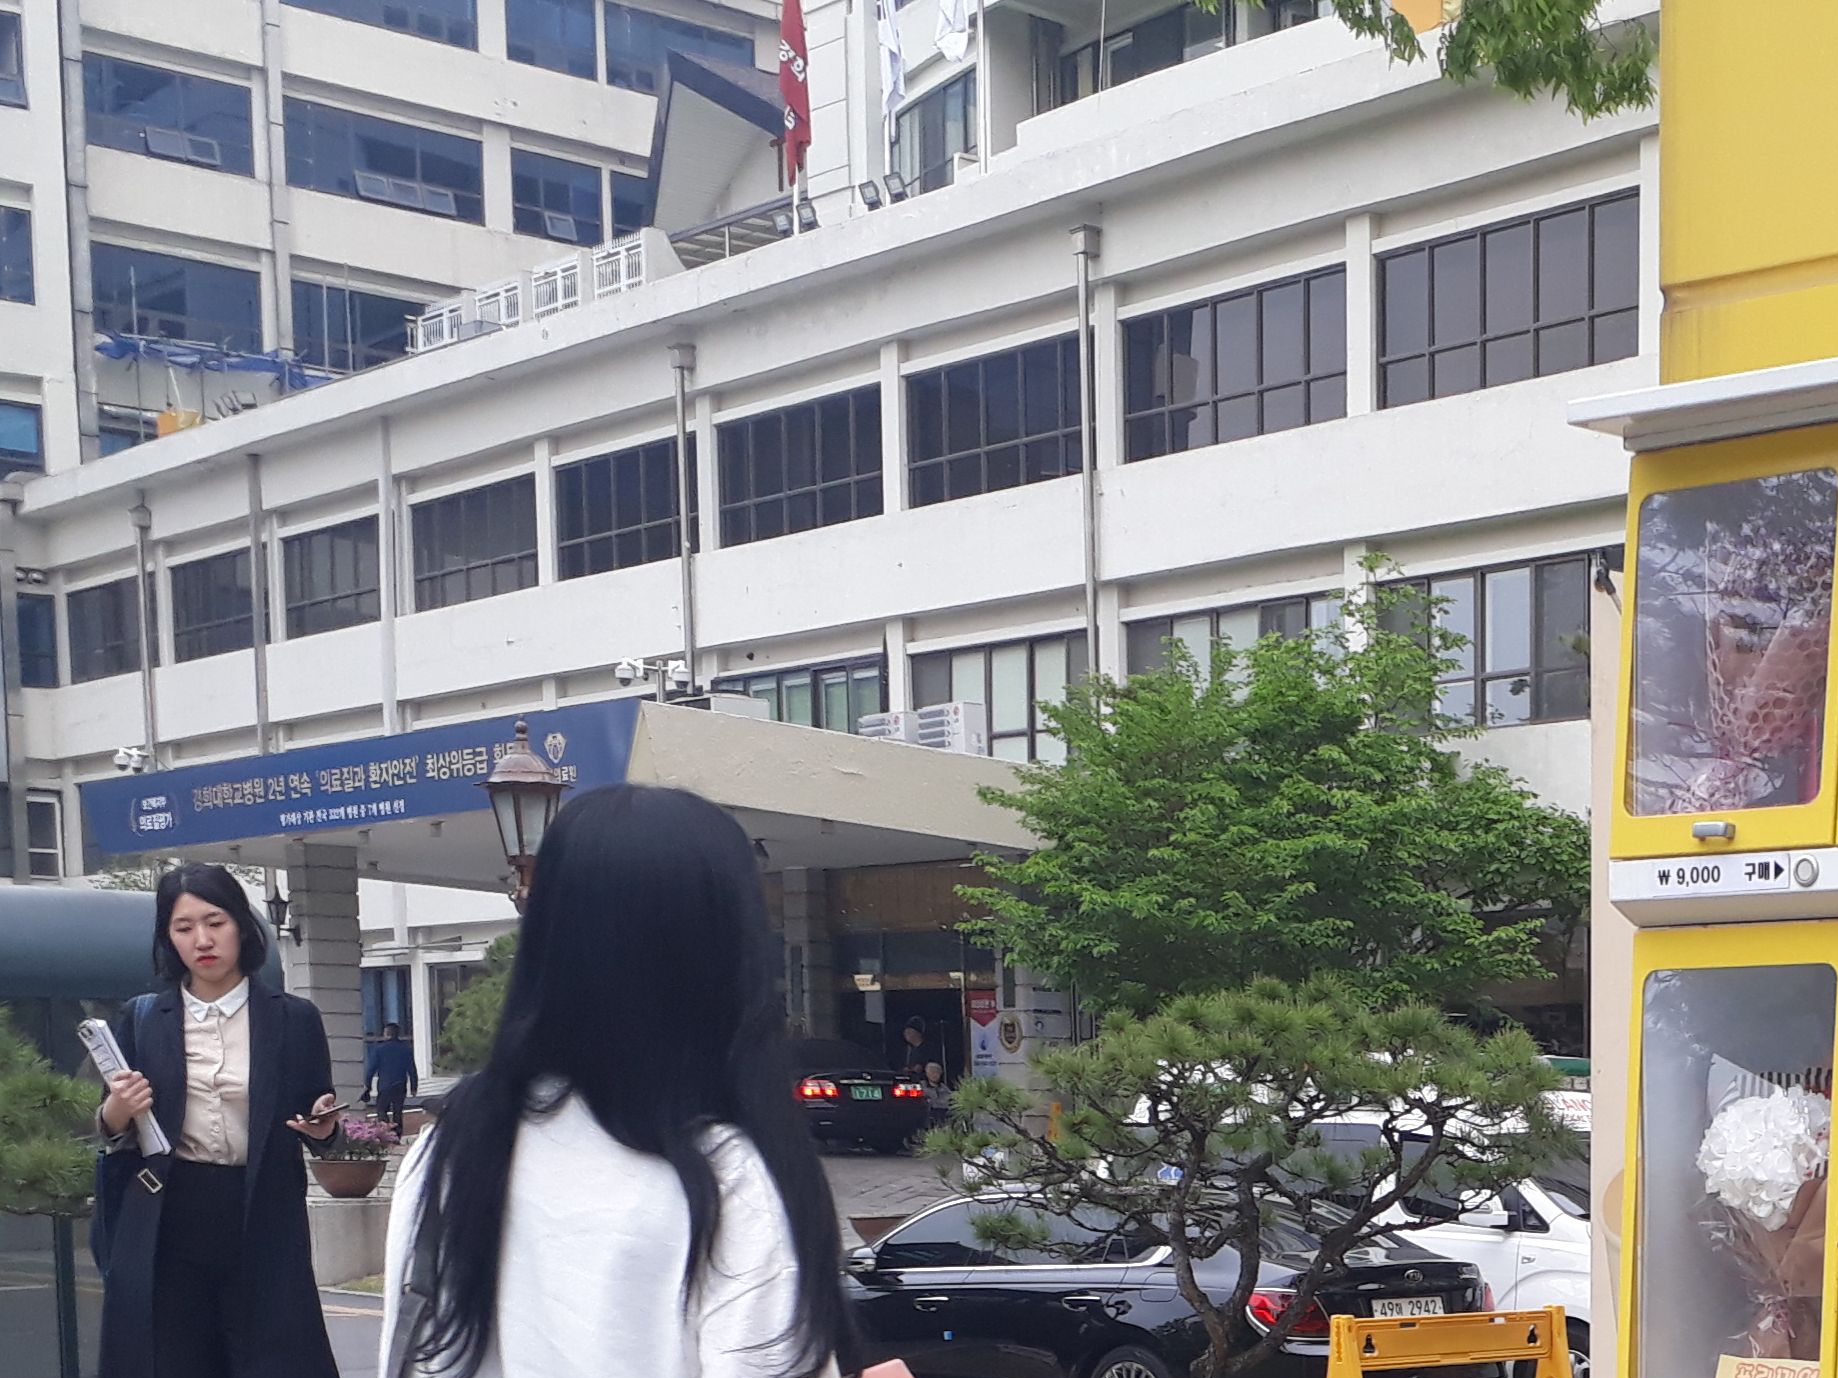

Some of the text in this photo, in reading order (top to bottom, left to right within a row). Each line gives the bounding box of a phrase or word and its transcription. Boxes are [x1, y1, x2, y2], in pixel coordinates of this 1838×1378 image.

[268, 777, 285, 800] 2년
[288, 774, 312, 798] 연속
[425, 746, 488, 780] 최상위등급
[1657, 862, 1771, 886] ₩ 9,000 구매
[1408, 1299, 1437, 1316] 2942
